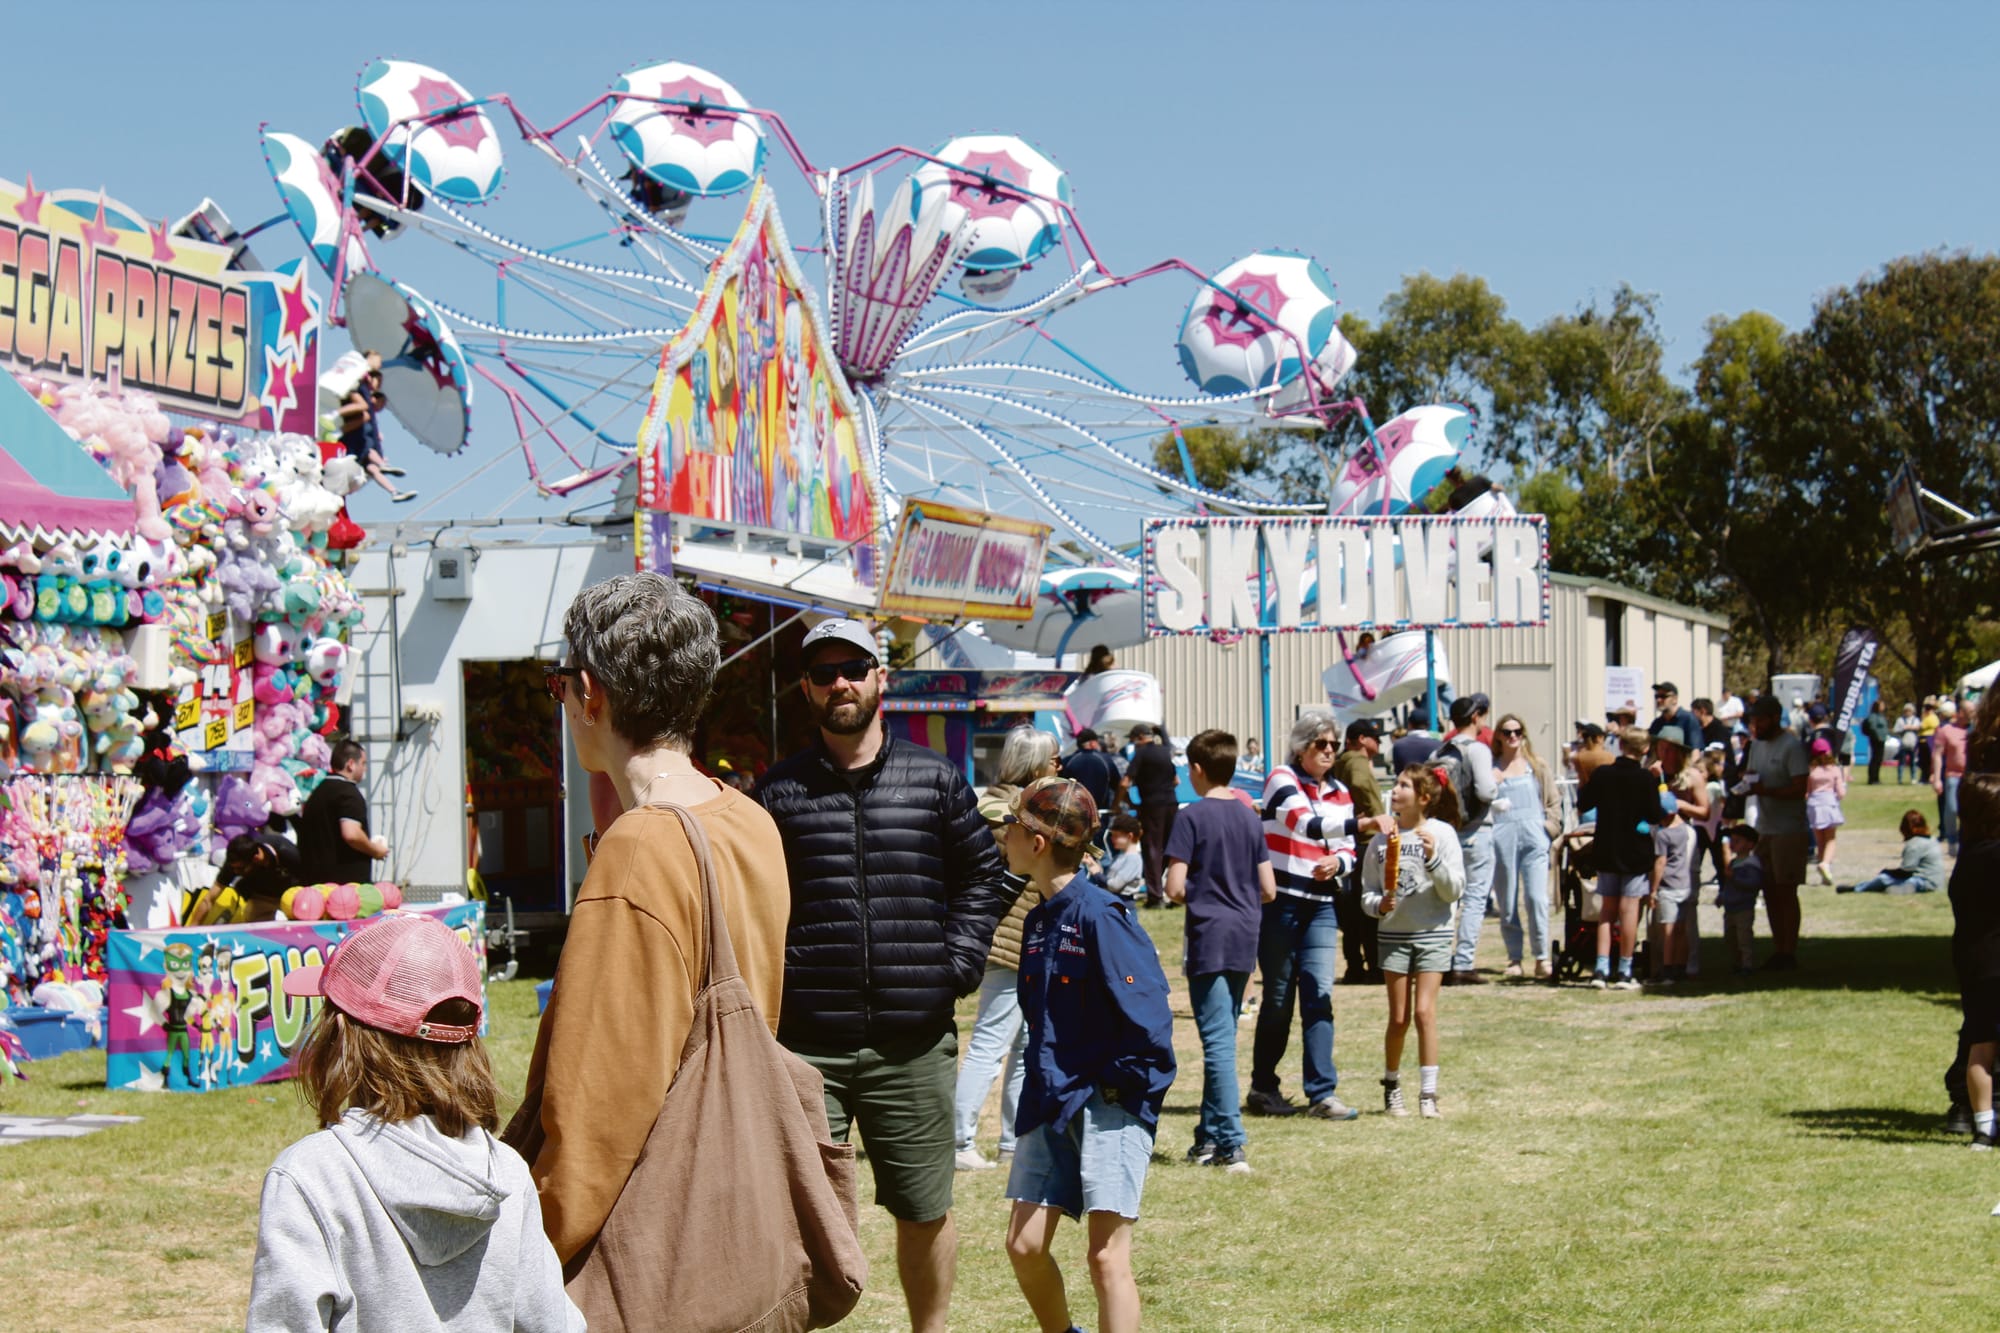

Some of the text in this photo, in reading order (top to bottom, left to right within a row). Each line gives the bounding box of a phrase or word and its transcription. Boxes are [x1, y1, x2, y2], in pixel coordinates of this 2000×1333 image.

[91, 248, 248, 409] PRIZES
[1155, 522, 1542, 631] SKYDIVER
[1836, 642, 1877, 732] BUBBLE TEA
